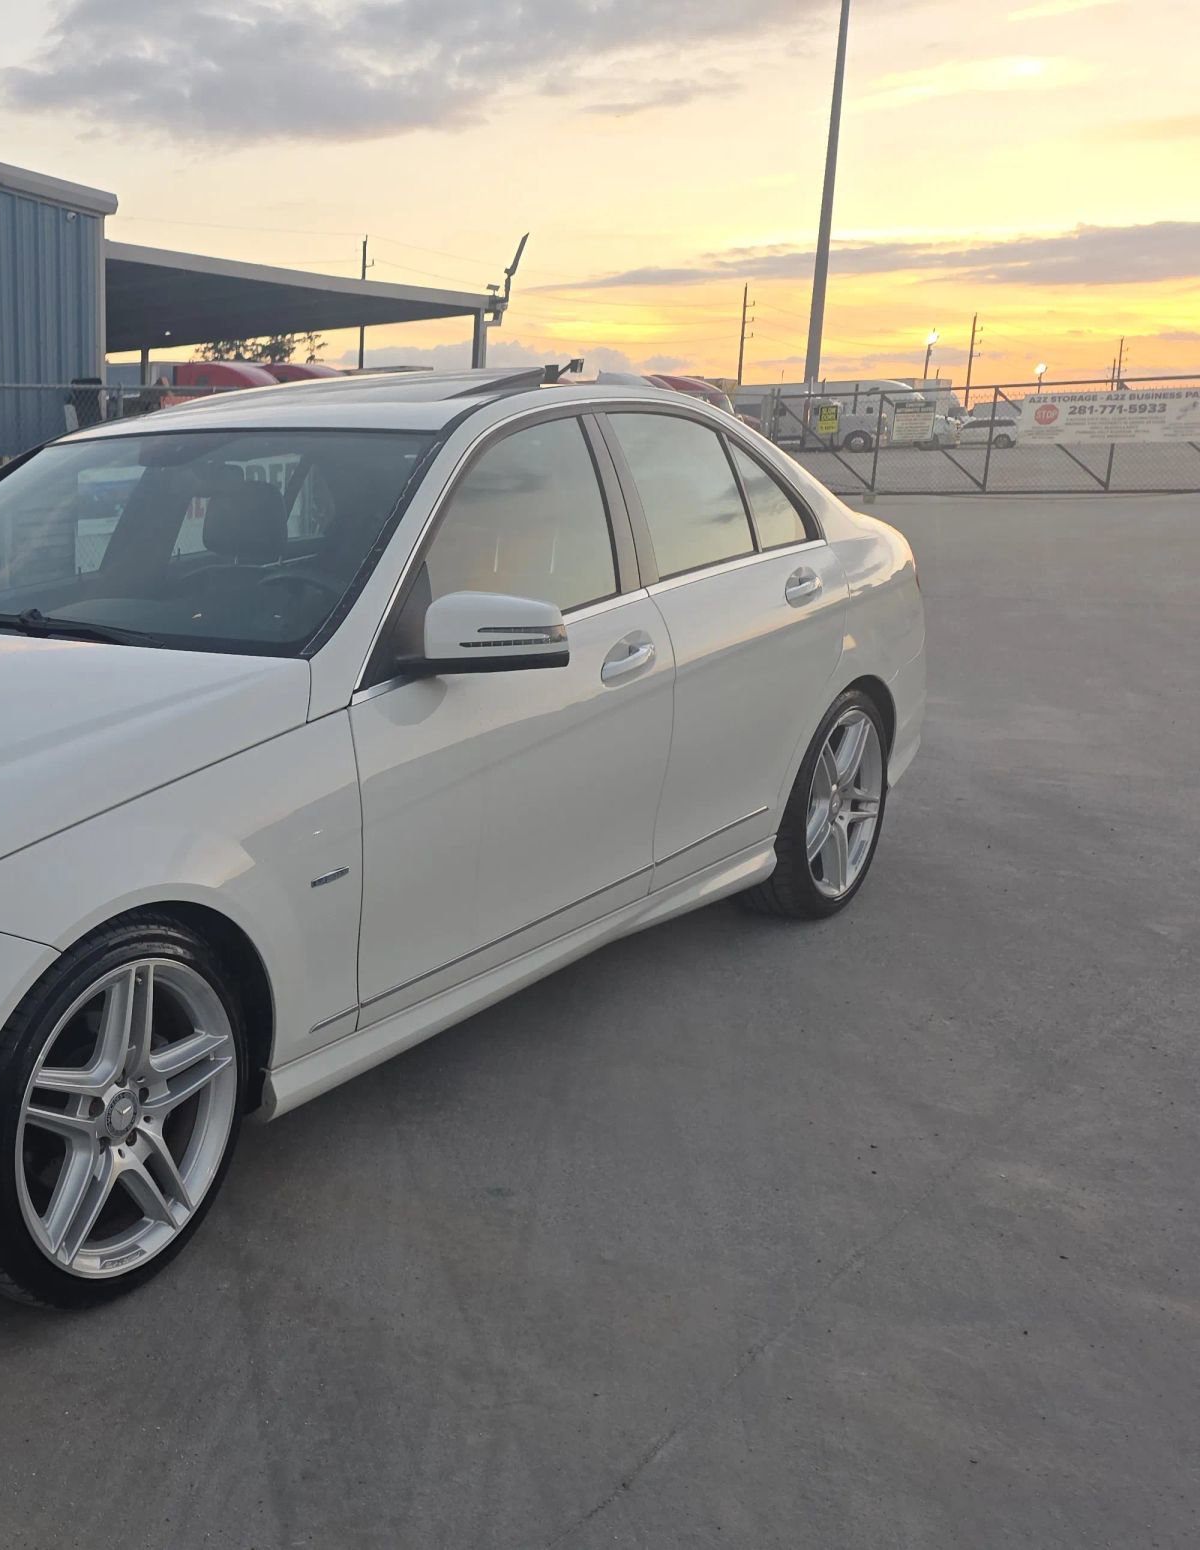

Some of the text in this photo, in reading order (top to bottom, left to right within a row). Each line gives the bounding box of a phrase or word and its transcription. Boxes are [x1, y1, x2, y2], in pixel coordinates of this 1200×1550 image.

[1051, 394, 1098, 403] STORAGE
[1106, 393, 1126, 401] A2Z
[1128, 391, 1182, 400] BUSINESS
[1068, 403, 1167, 416] 281-771-5933
